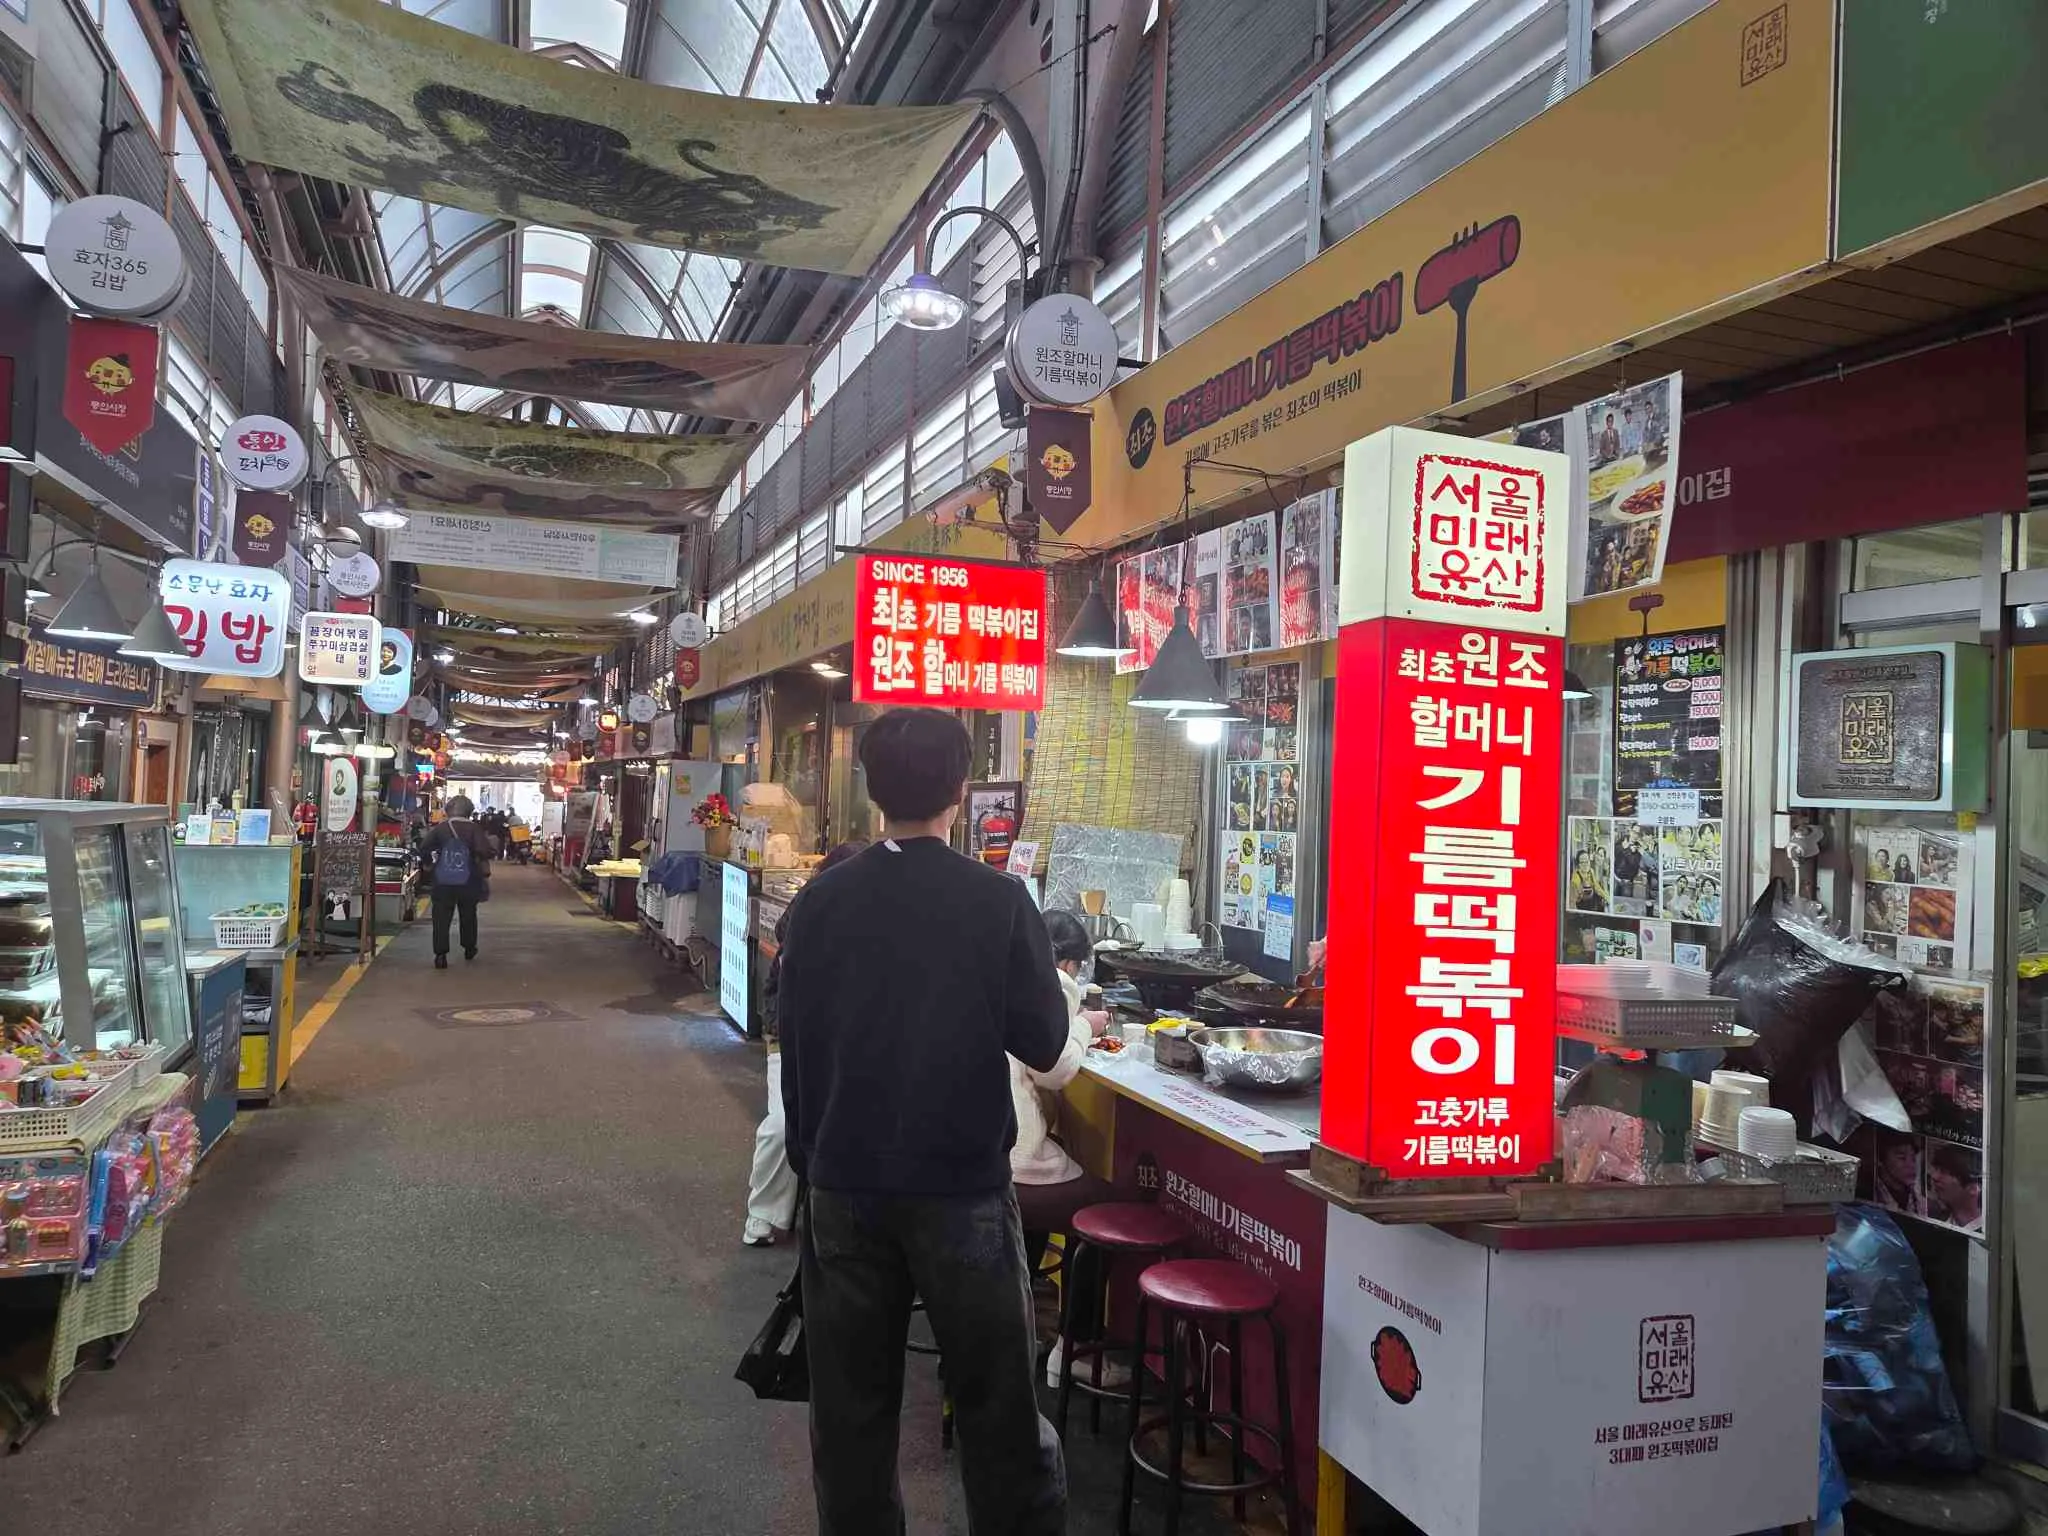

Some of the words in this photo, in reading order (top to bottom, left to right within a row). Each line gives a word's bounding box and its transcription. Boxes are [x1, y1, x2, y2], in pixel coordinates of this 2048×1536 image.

[1746, 9, 1783, 45] 서울
[1746, 31, 1782, 61] 미래
[1746, 47, 1782, 79] 유산
[73, 249, 148, 275] 효자365
[90, 271, 127, 292] 김밥
[1034, 346, 1102, 369] 원조할머니
[1163, 271, 1404, 446] 원조할머니기름떡볶이
[1034, 366, 1101, 389] 기름떡볶이
[1262, 408, 1283, 430] 볶은
[1324, 369, 1362, 401] 떡볶이
[1430, 473, 1530, 520] 서울
[1677, 467, 1732, 506] 이집
[1430, 514, 1529, 556] 미래
[168, 574, 223, 595] 소문난
[229, 579, 273, 602] 효자
[872, 560, 925, 584] SINCE
[931, 566, 969, 588] 1956
[1428, 549, 1529, 599] 유산
[871, 586, 918, 633] 최초
[924, 601, 962, 636] 기름
[967, 604, 1039, 641] 떡볶이집
[23, 639, 76, 679] 계절메뉴로
[77, 651, 104, 685] 대접해
[104, 656, 150, 692] 드리겠습니다
[871, 634, 916, 692] 원조
[923, 638, 969, 695] 할머니
[973, 661, 998, 694] 기름
[1001, 663, 1038, 696] 떡볶이
[1398, 648, 1456, 683] 최초
[1457, 632, 1549, 690] 원조
[1845, 697, 1889, 719] 서울
[1409, 695, 1533, 756] 할머니
[1845, 719, 1887, 737] 미래
[1844, 736, 1888, 759] 유산
[1405, 765, 1527, 1086] 기름떡볶이
[1414, 1096, 1510, 1128] 고춧가루
[1403, 1134, 1521, 1166] 기름떡볶이
[1166, 1169, 1302, 1272] 원조할머니기름떡볶이
[1358, 1274, 1443, 1336] 원조할머니기름떡볶이
[1646, 1321, 1689, 1347] 서울
[1645, 1348, 1689, 1370] 미래
[1645, 1370, 1688, 1395] 유산
[1594, 1426, 1619, 1445] 서울
[1623, 1417, 1695, 1441] 미래유산으로
[1609, 1446, 1644, 1465] 3대째
[1648, 1436, 1718, 1460] 원조떡볶이집
